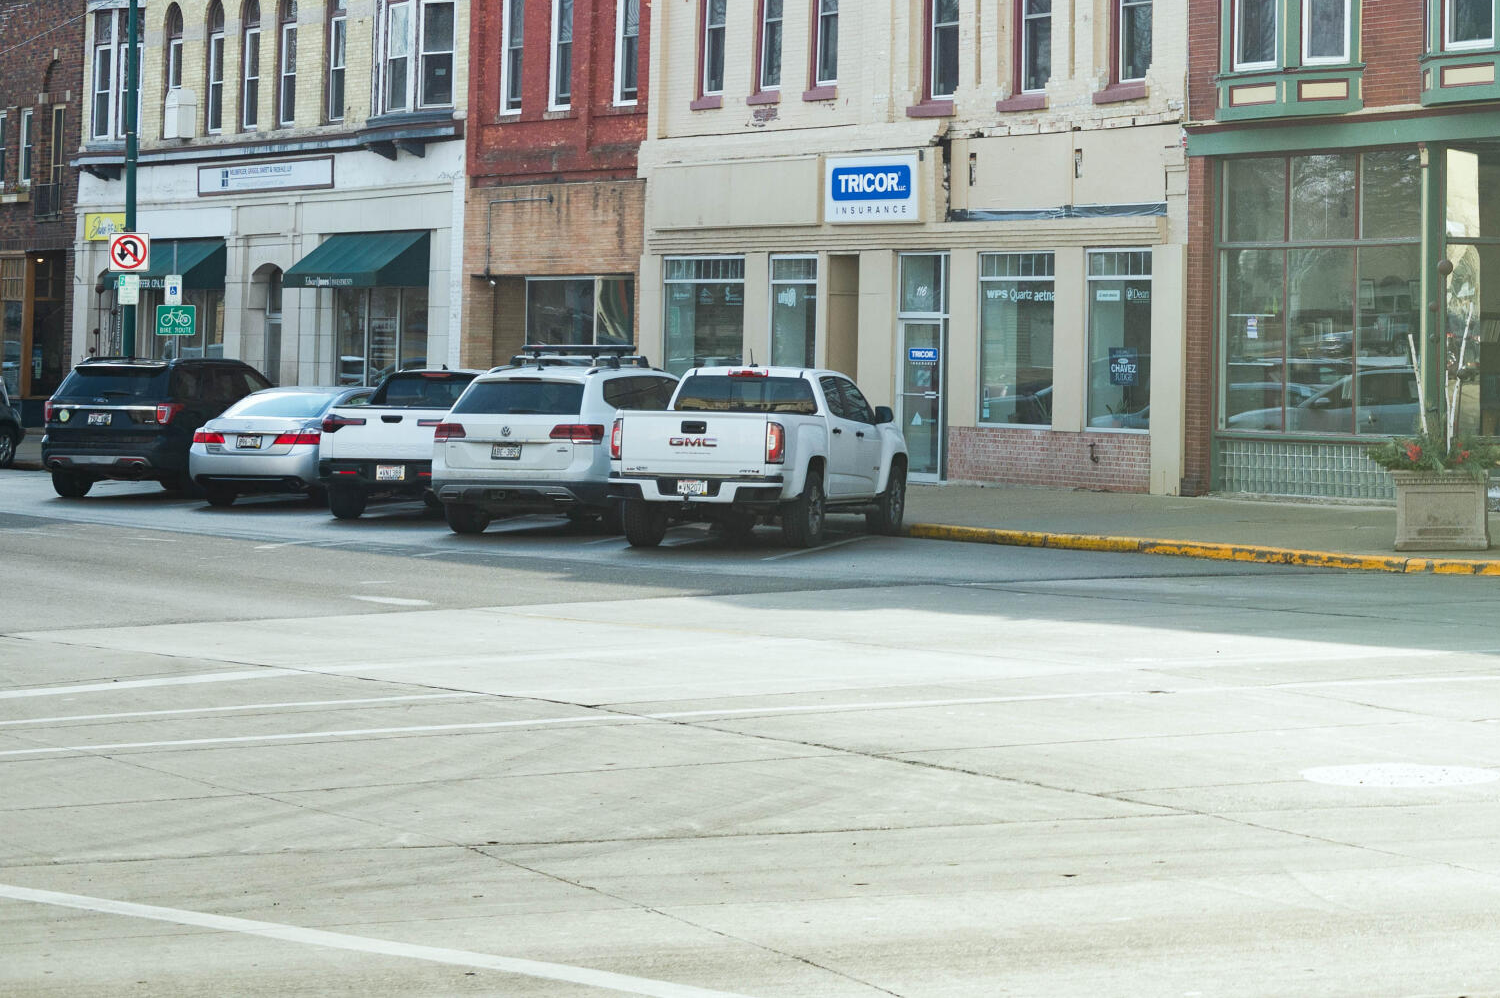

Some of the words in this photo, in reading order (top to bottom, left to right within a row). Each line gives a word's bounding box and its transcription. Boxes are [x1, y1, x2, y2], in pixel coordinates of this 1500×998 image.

[837, 172, 899, 193] TRICOR
[835, 205, 906, 215] INSURANCE
[916, 286, 928, 297] 116
[987, 289, 1008, 299] WPS
[1010, 288, 1032, 302] Quartz
[911, 350, 934, 358] TRICOR
[1111, 363, 1137, 373] CHAVEZ
[669, 437, 717, 447] GMC
